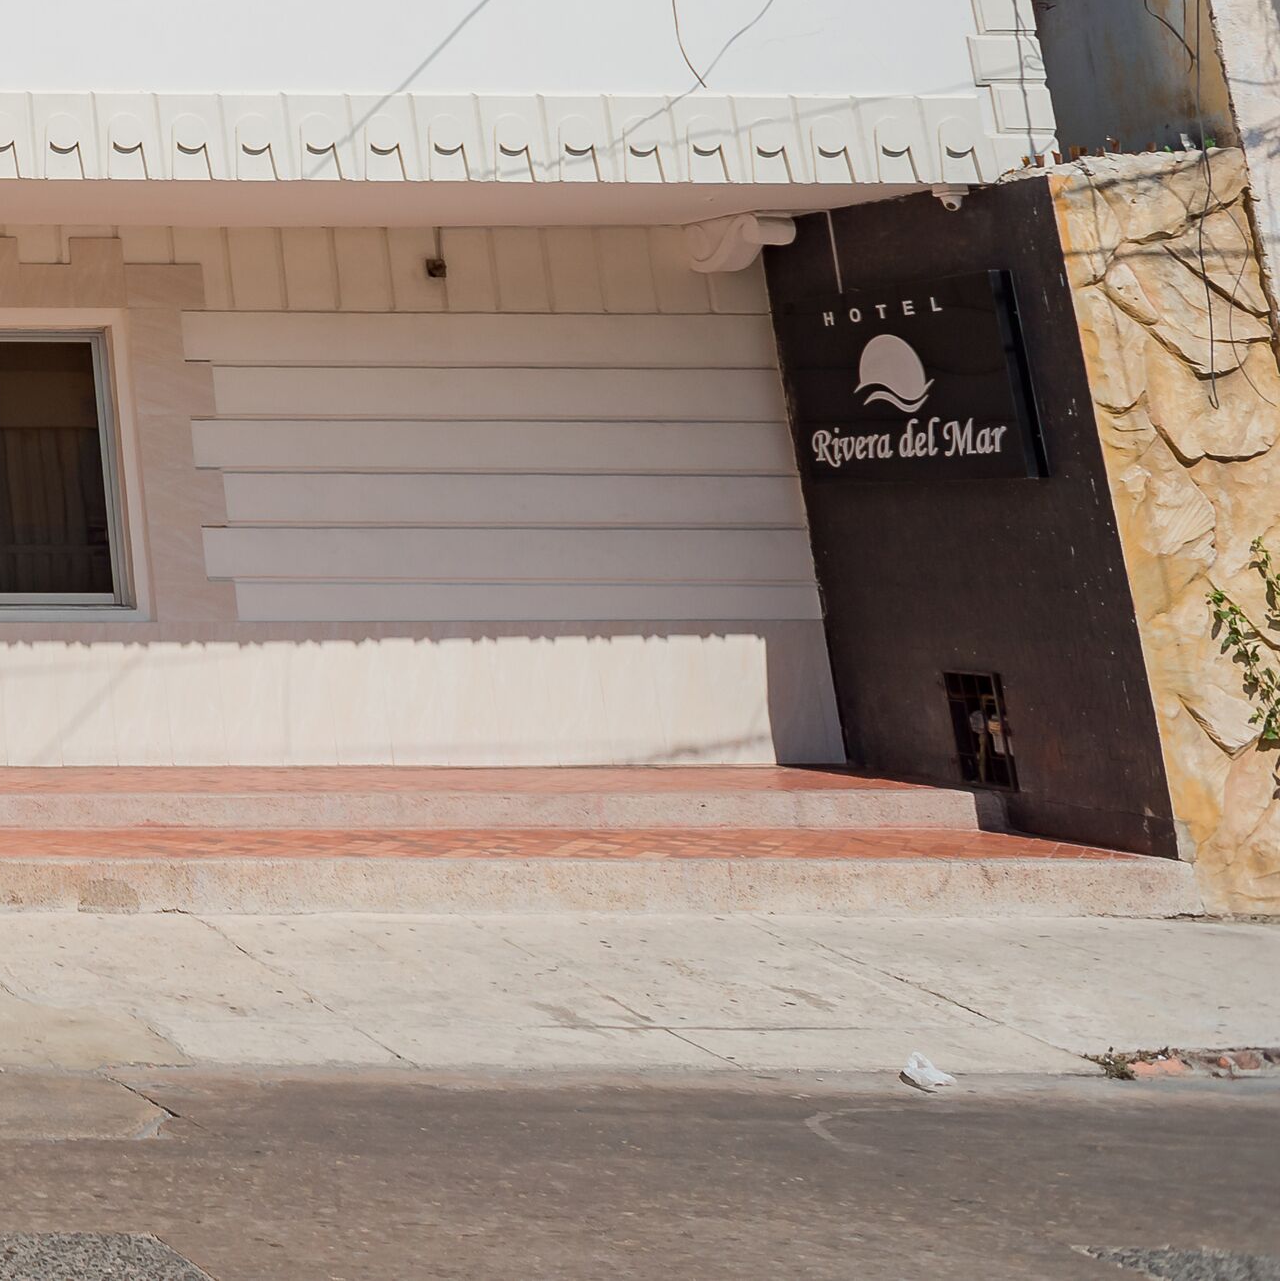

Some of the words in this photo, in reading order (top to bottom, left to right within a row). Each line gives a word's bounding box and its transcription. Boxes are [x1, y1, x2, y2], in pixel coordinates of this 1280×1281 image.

[822, 296, 943, 327] HOTEL
[812, 427, 893, 468] Rivera
[899, 417, 940, 458] del
[942, 417, 1007, 457] Mar
